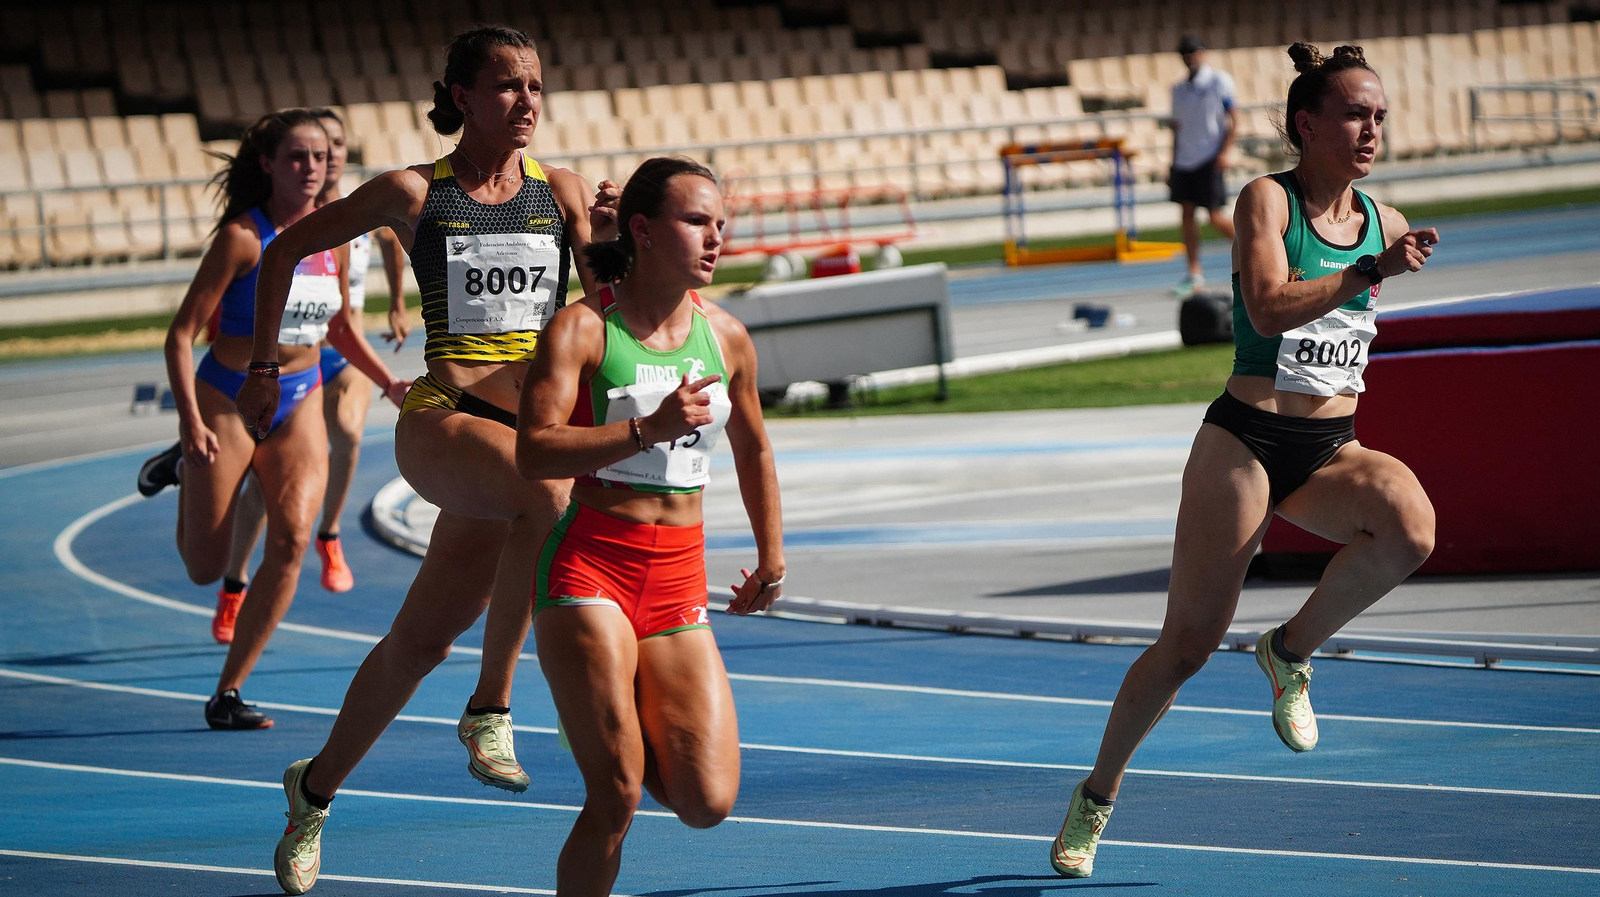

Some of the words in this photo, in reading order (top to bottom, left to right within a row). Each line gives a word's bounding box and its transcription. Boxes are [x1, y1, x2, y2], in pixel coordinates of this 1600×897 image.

[529, 218, 553, 226] SPRINT
[465, 266, 547, 296] 8007
[293, 300, 328, 319] 106
[455, 316, 489, 324] Competiciones
[1295, 338, 1361, 368] 8002
[606, 466, 644, 478] Competiciones
